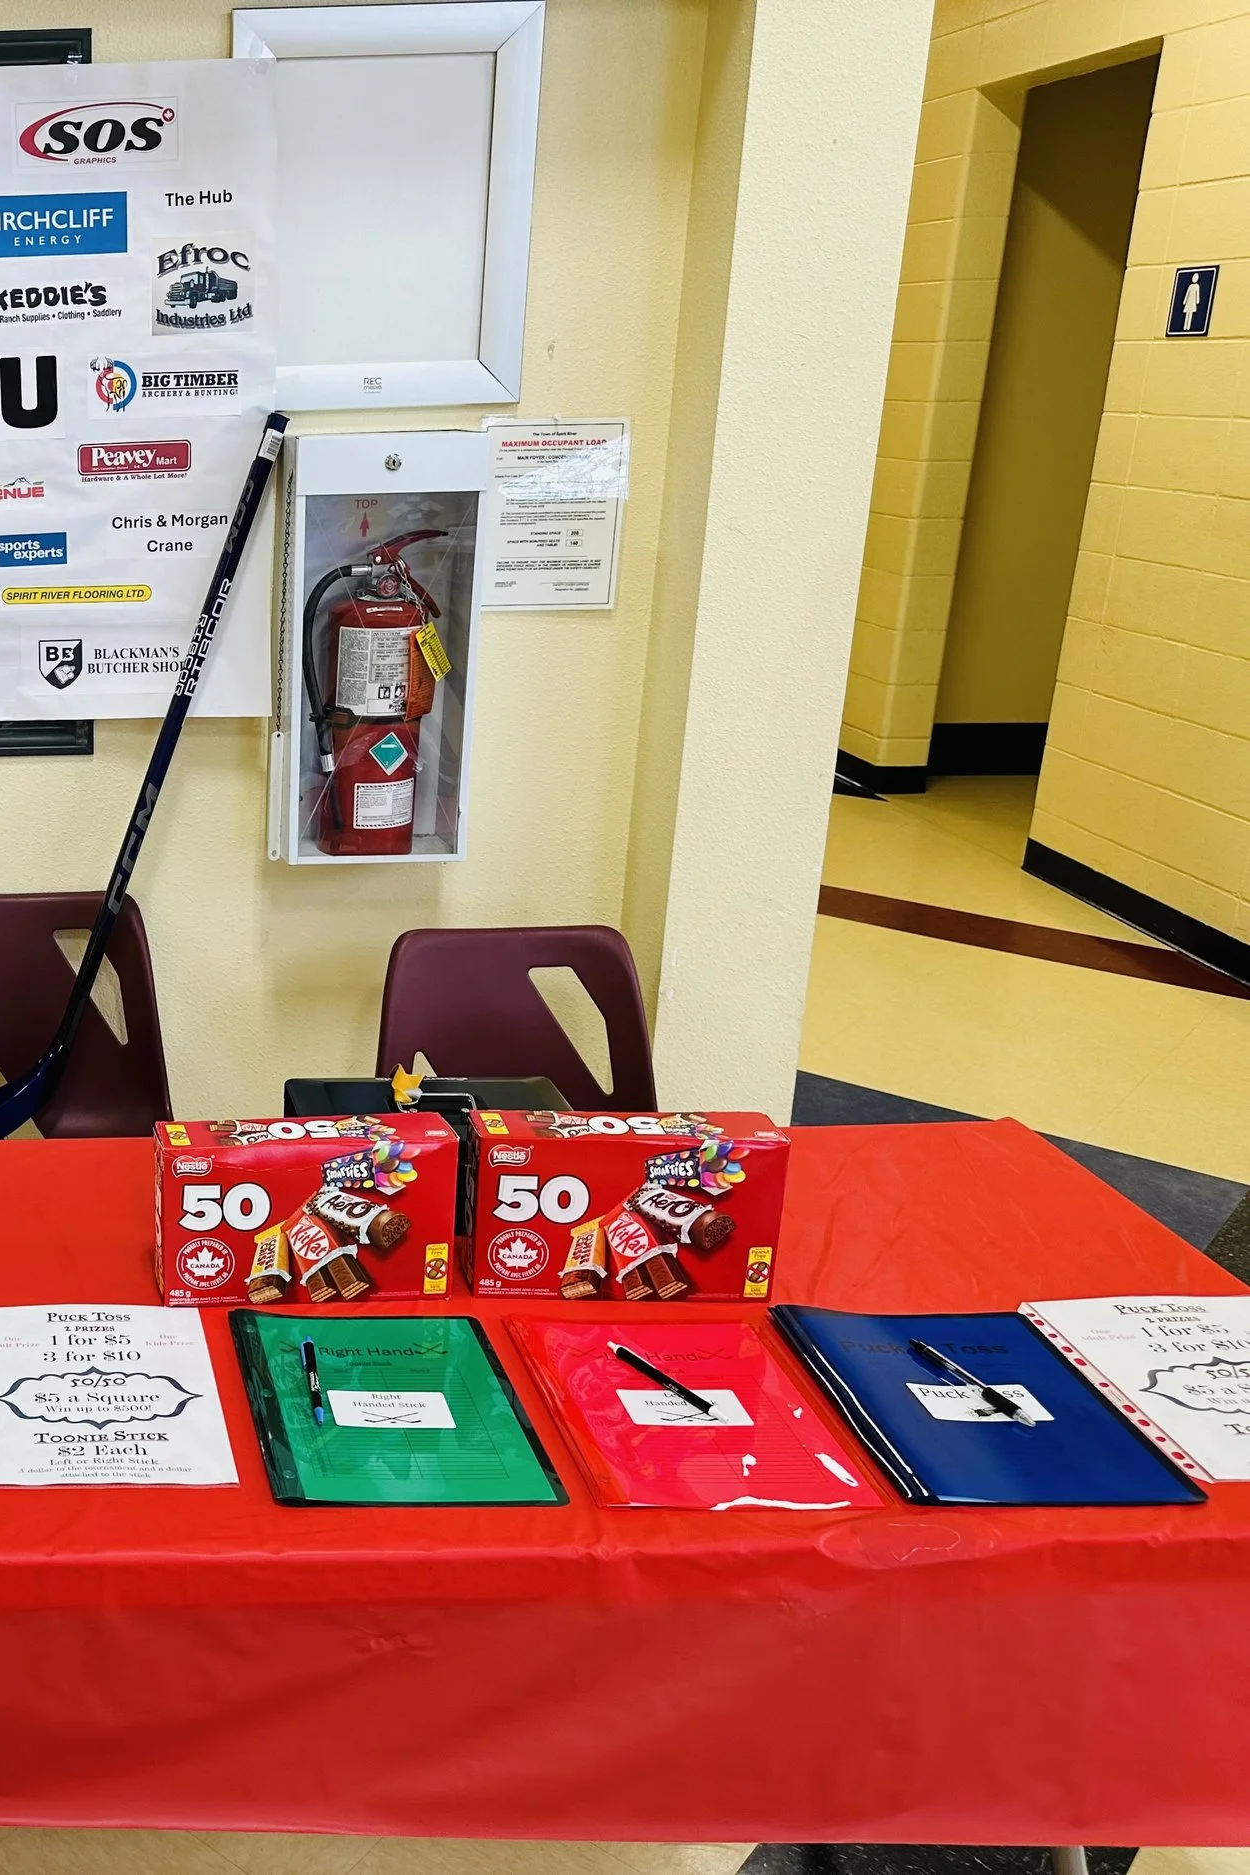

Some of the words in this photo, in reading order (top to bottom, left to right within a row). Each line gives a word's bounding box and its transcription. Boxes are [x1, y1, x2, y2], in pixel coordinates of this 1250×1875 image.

[43, 116, 165, 155] SOS
[73, 156, 117, 165] GRAPHICS
[165, 193, 195, 207] The
[199, 190, 233, 205] Hub
[14, 234, 83, 247] ENERGY
[155, 242, 251, 279] Efroc
[0, 313, 21, 323] Ranch
[22, 311, 51, 323] Supplies
[57, 310, 86, 322] Clothing
[92, 308, 123, 320] Saddlery
[155, 307, 227, 330] Industries
[229, 302, 254, 324] Ltd
[142, 375, 171, 387] BIG
[173, 373, 238, 387] TIMBER
[363, 377, 382, 385] REC
[142, 390, 183, 398] ARCHERY
[541, 439, 583, 447] OCCUPANT
[92, 447, 156, 468] Peavey
[156, 456, 177, 465] Mart
[354, 499, 378, 509] TOP
[111, 515, 152, 529] Chris
[156, 516, 168, 528] &
[171, 513, 229, 531] Morgan
[146, 539, 193, 552] Crane
[14, 546, 64, 561] experts
[6, 591, 39, 601] SPIRIT
[40, 590, 71, 600] RIVER
[72, 588, 125, 600] FLOORING
[184, 578, 232, 697] RIBCOR
[94, 646, 180, 660] BLACKMAN'S
[87, 661, 150, 675] BUTCHER
[107, 782, 159, 915] CCM
[588, 1116, 665, 1135] 50
[492, 1174, 590, 1224] 50
[178, 1182, 271, 1232] 50
[1141, 1326, 1152, 1337] 1
[1159, 1325, 1192, 1337] for
[1197, 1324, 1230, 1334] $5
[50, 1335, 58, 1346] 1
[67, 1334, 98, 1346] for
[105, 1334, 132, 1346] $5
[43, 1352, 57, 1363] 3
[65, 1350, 96, 1362] for
[103, 1350, 142, 1362] $10
[319, 1347, 362, 1358] Right
[367, 1347, 414, 1356] Hand
[70, 1375, 127, 1388] 50/50
[34, 1392, 60, 1404] $5
[68, 1394, 81, 1403] a
[87, 1391, 160, 1405] Square
[371, 1393, 401, 1401] Right
[918, 1387, 971, 1399] Puck
[45, 1405, 72, 1413] Win
[77, 1405, 93, 1414] up
[97, 1405, 109, 1413] to
[57, 1446, 85, 1457] $2
[95, 1444, 147, 1456] Each
[50, 1458, 73, 1466] Left
[93, 1457, 124, 1467] Right
[128, 1457, 159, 1465] Stick
